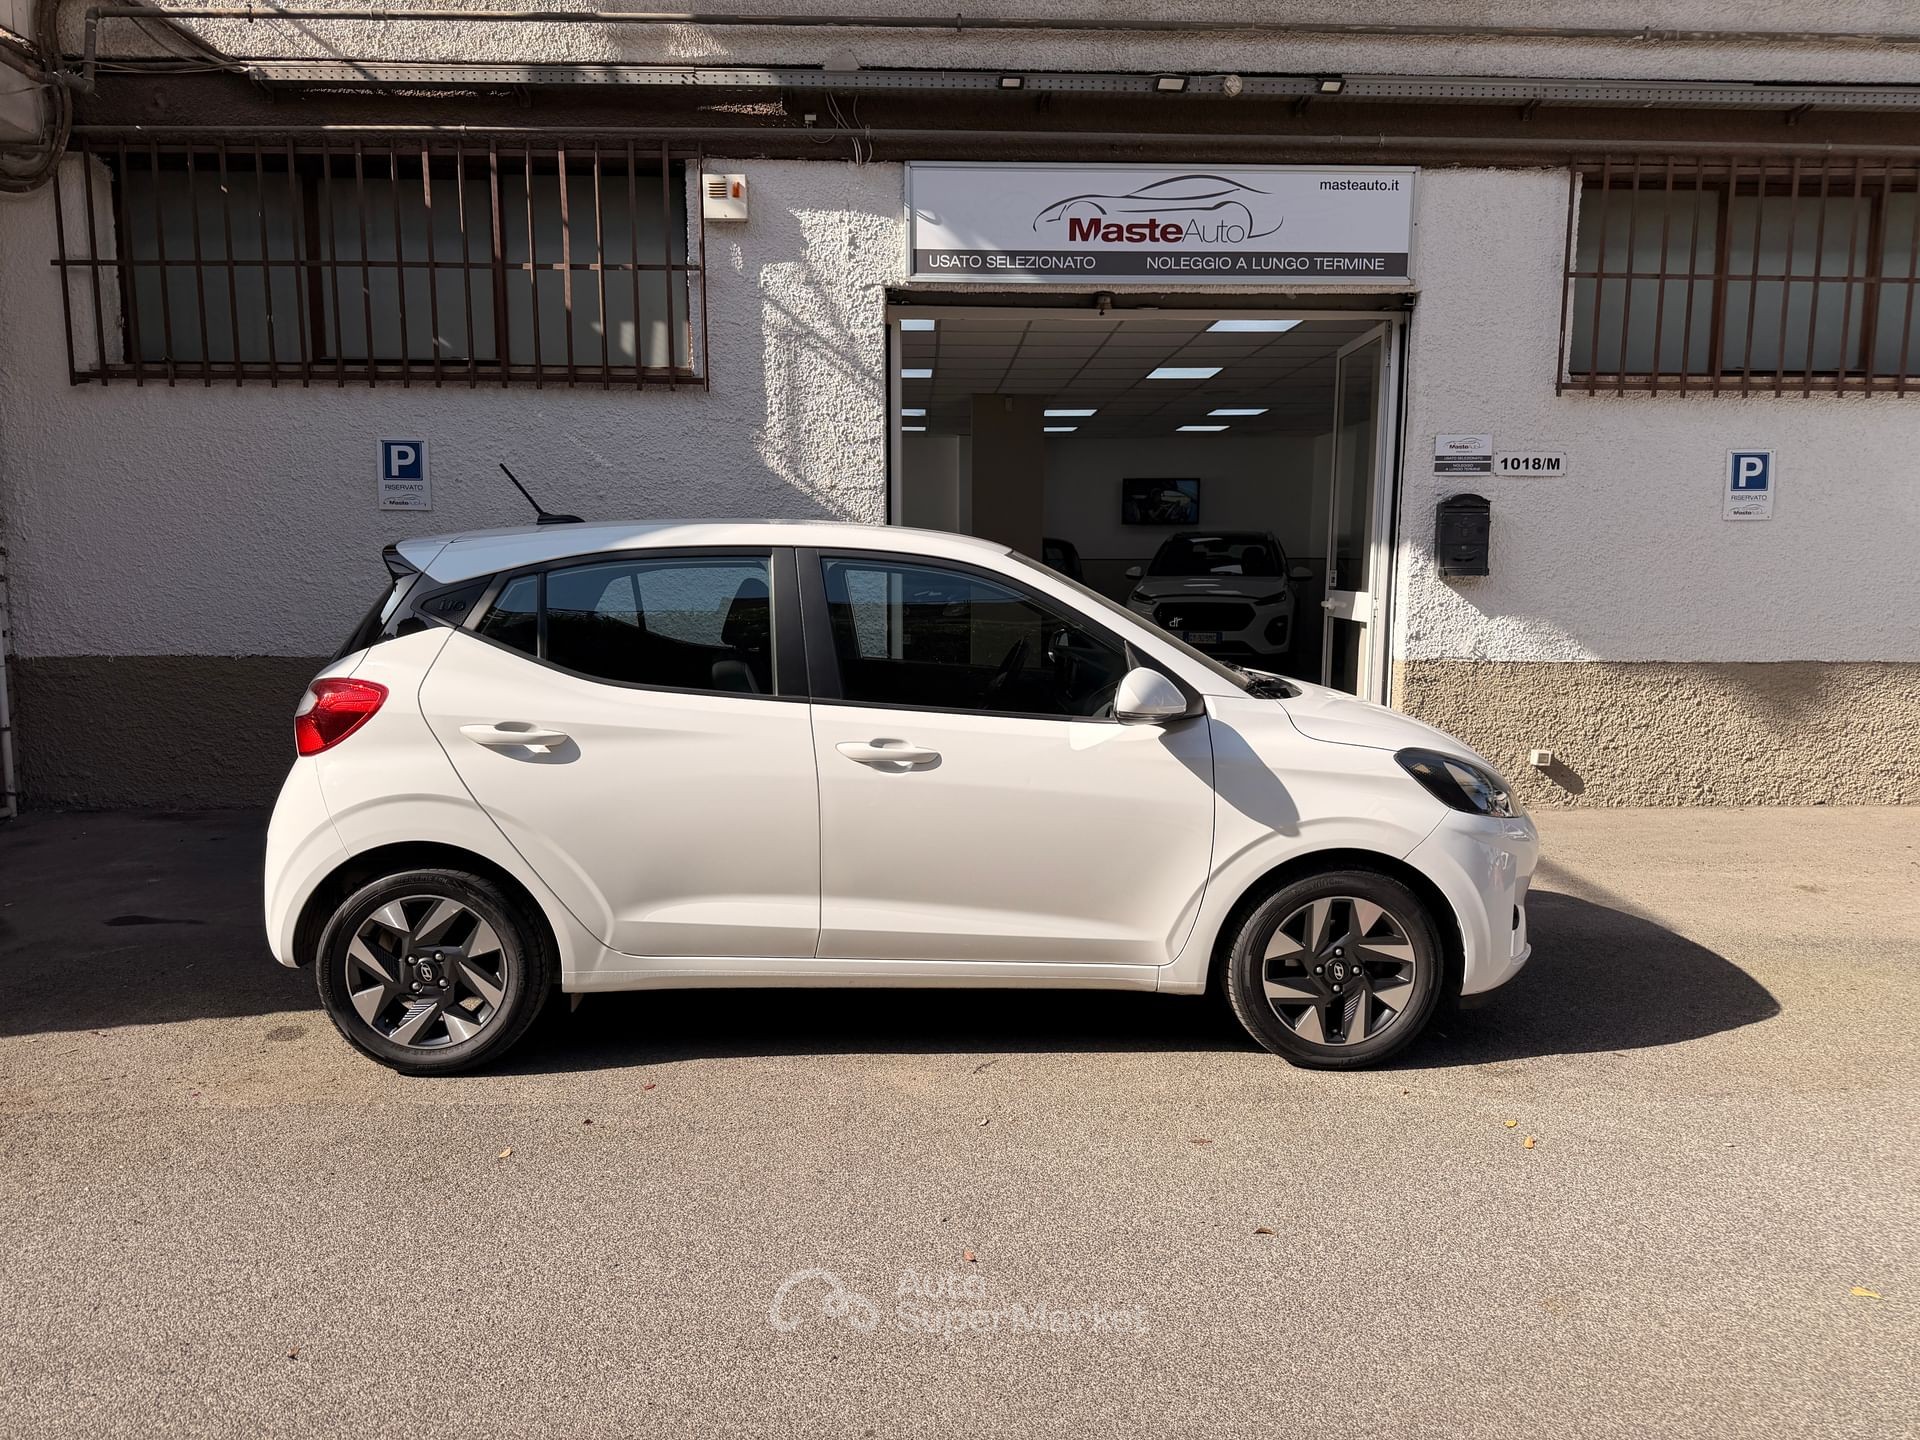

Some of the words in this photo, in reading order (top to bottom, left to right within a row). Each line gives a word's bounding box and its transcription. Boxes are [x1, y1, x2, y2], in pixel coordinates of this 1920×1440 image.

[1319, 179, 1400, 192] masteauto.it
[1068, 217, 1246, 243] MasteAuto
[928, 254, 982, 268] USATO
[986, 255, 1097, 270] SELEZIONATO
[1146, 256, 1232, 271] NOLEGGIO
[1236, 257, 1248, 270] A
[1252, 257, 1310, 271] LUNGO
[1314, 257, 1386, 271] TERMINE
[391, 445, 416, 476] P
[1500, 457, 1560, 471] 1018/M
[1739, 457, 1763, 487] P
[384, 483, 424, 491] RISERVATO
